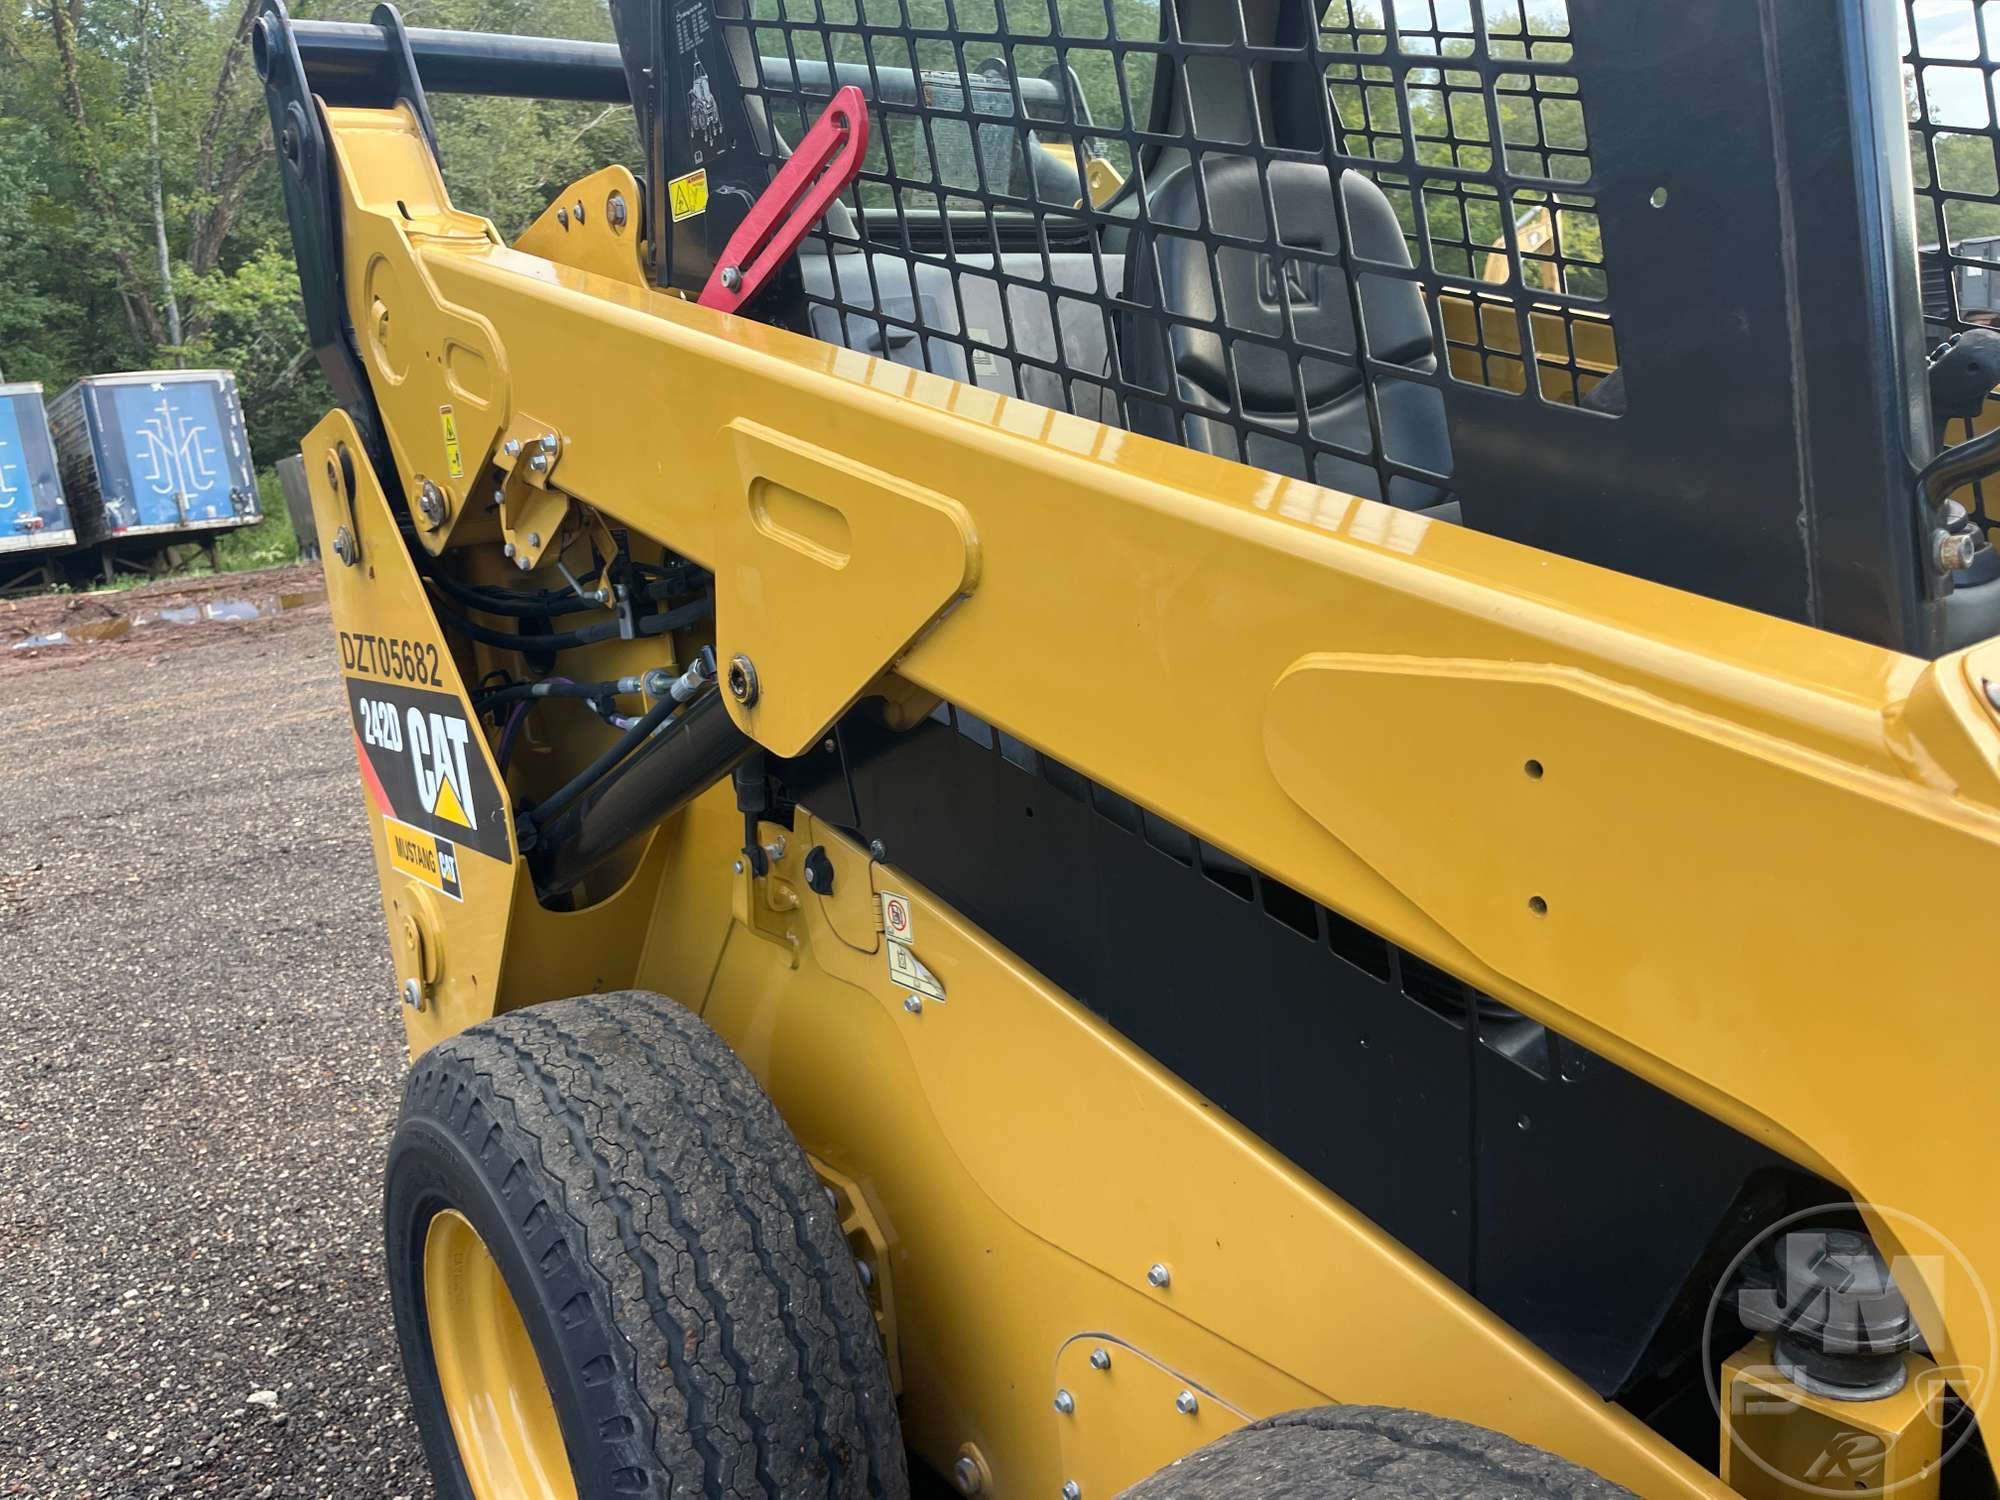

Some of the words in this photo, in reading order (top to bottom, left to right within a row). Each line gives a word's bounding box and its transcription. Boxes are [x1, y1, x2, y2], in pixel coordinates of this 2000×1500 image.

[340, 631, 443, 687] DZT05682
[359, 697, 403, 752] 242D
[406, 706, 478, 831] CAT
[394, 835, 437, 874] MUSTANG
[438, 851, 457, 883] CAT
